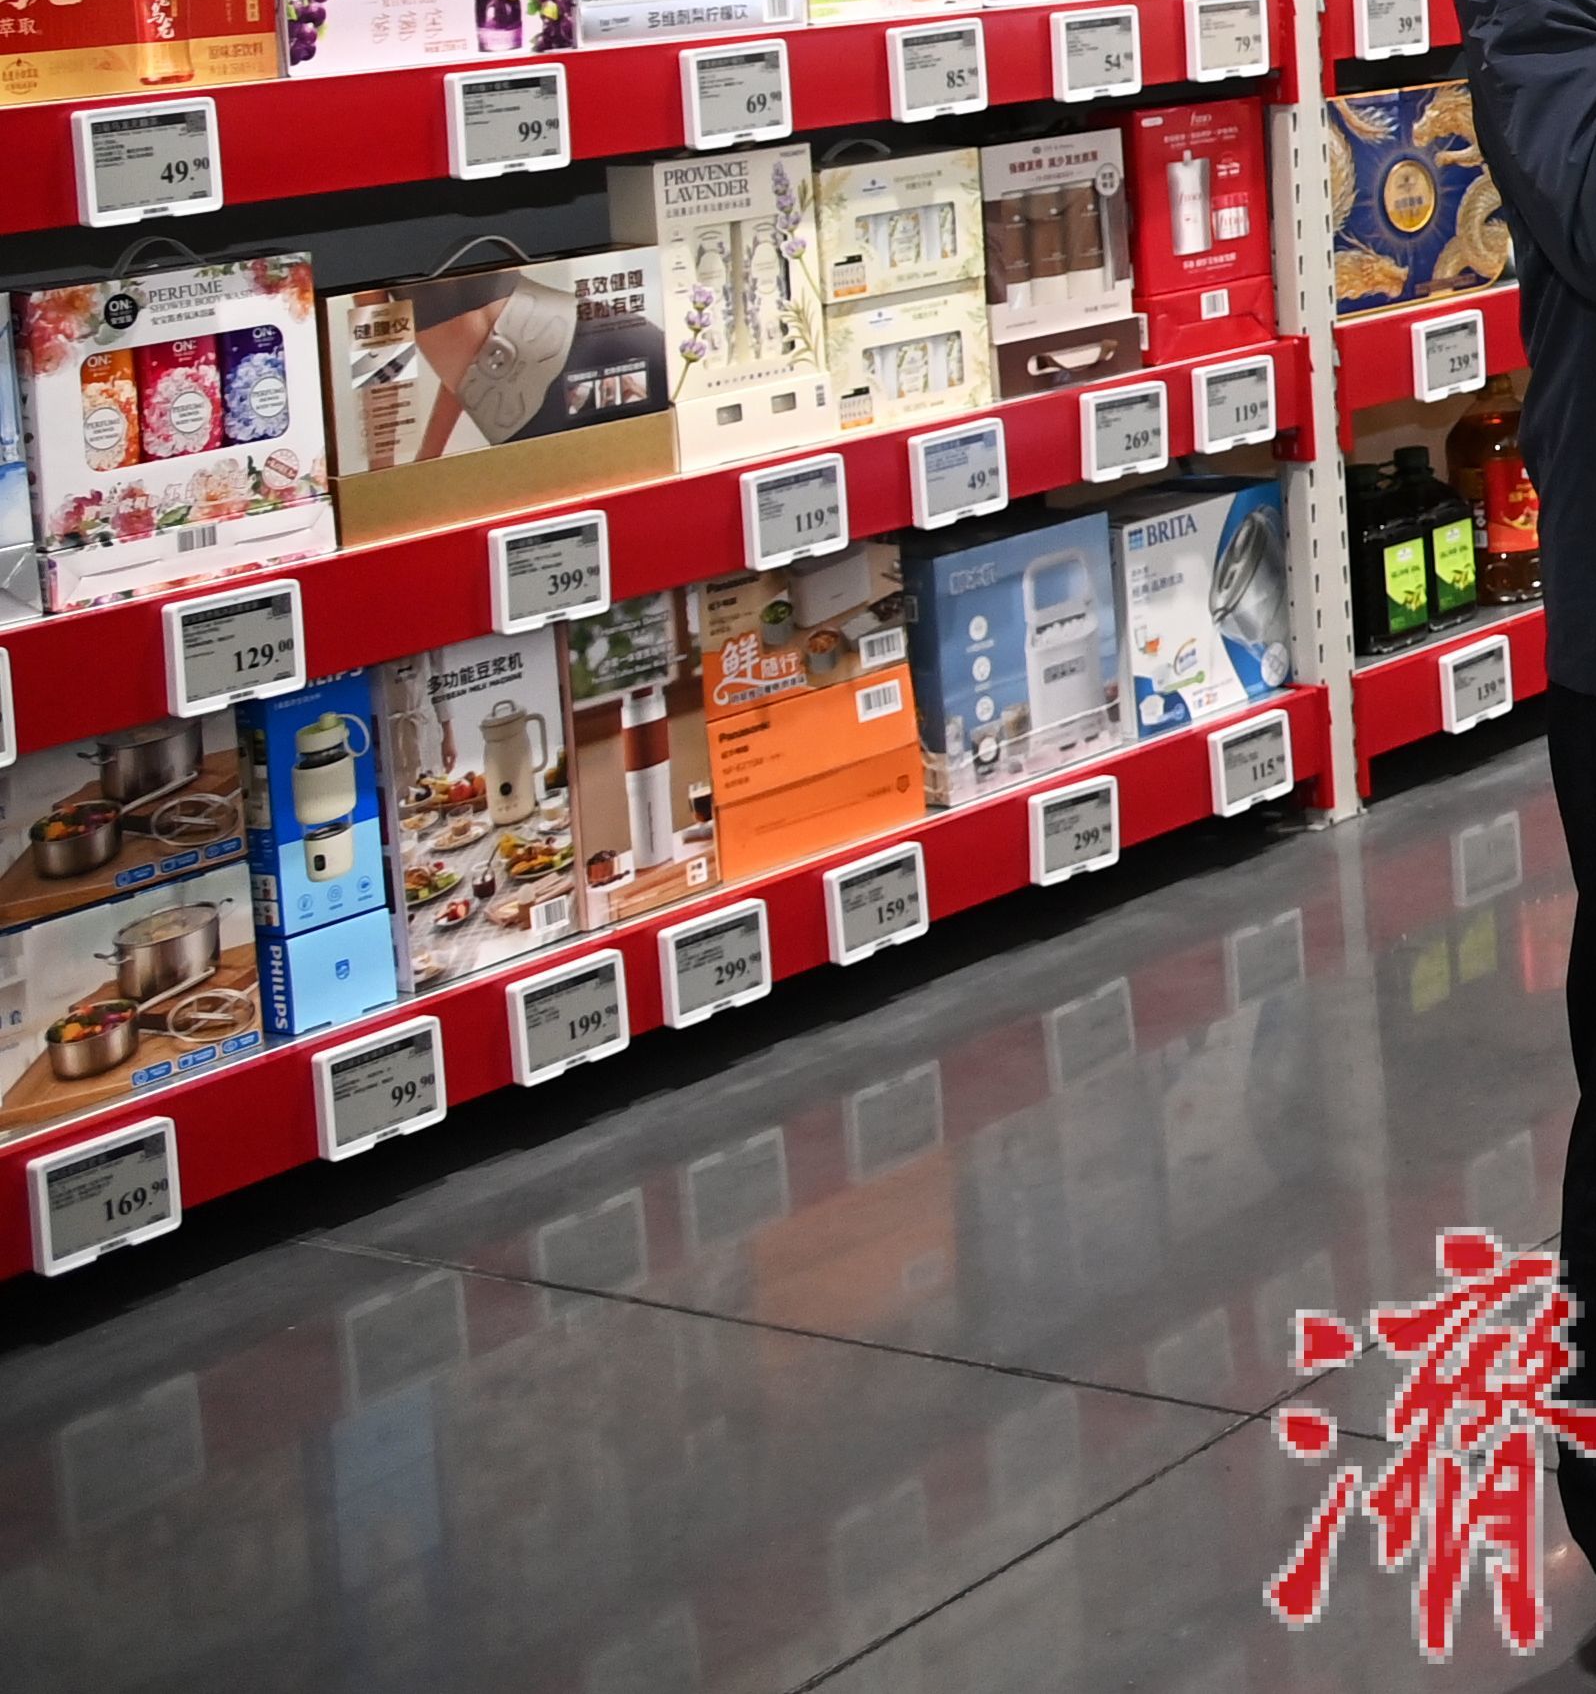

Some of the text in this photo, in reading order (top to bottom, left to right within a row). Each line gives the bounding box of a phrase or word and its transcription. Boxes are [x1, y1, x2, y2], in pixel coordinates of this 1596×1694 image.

[664, 160, 749, 186] PROVENCE
[665, 179, 749, 205] LAVENDER
[149, 280, 223, 303] PERFUME
[195, 294, 222, 307] BODY
[353, 317, 411, 341] 健腹仪
[1146, 513, 1198, 547] BRITA
[427, 652, 525, 695] 多功能豆浆机
[718, 721, 771, 743] Panasonic
[269, 944, 289, 1030] PHILIPS
